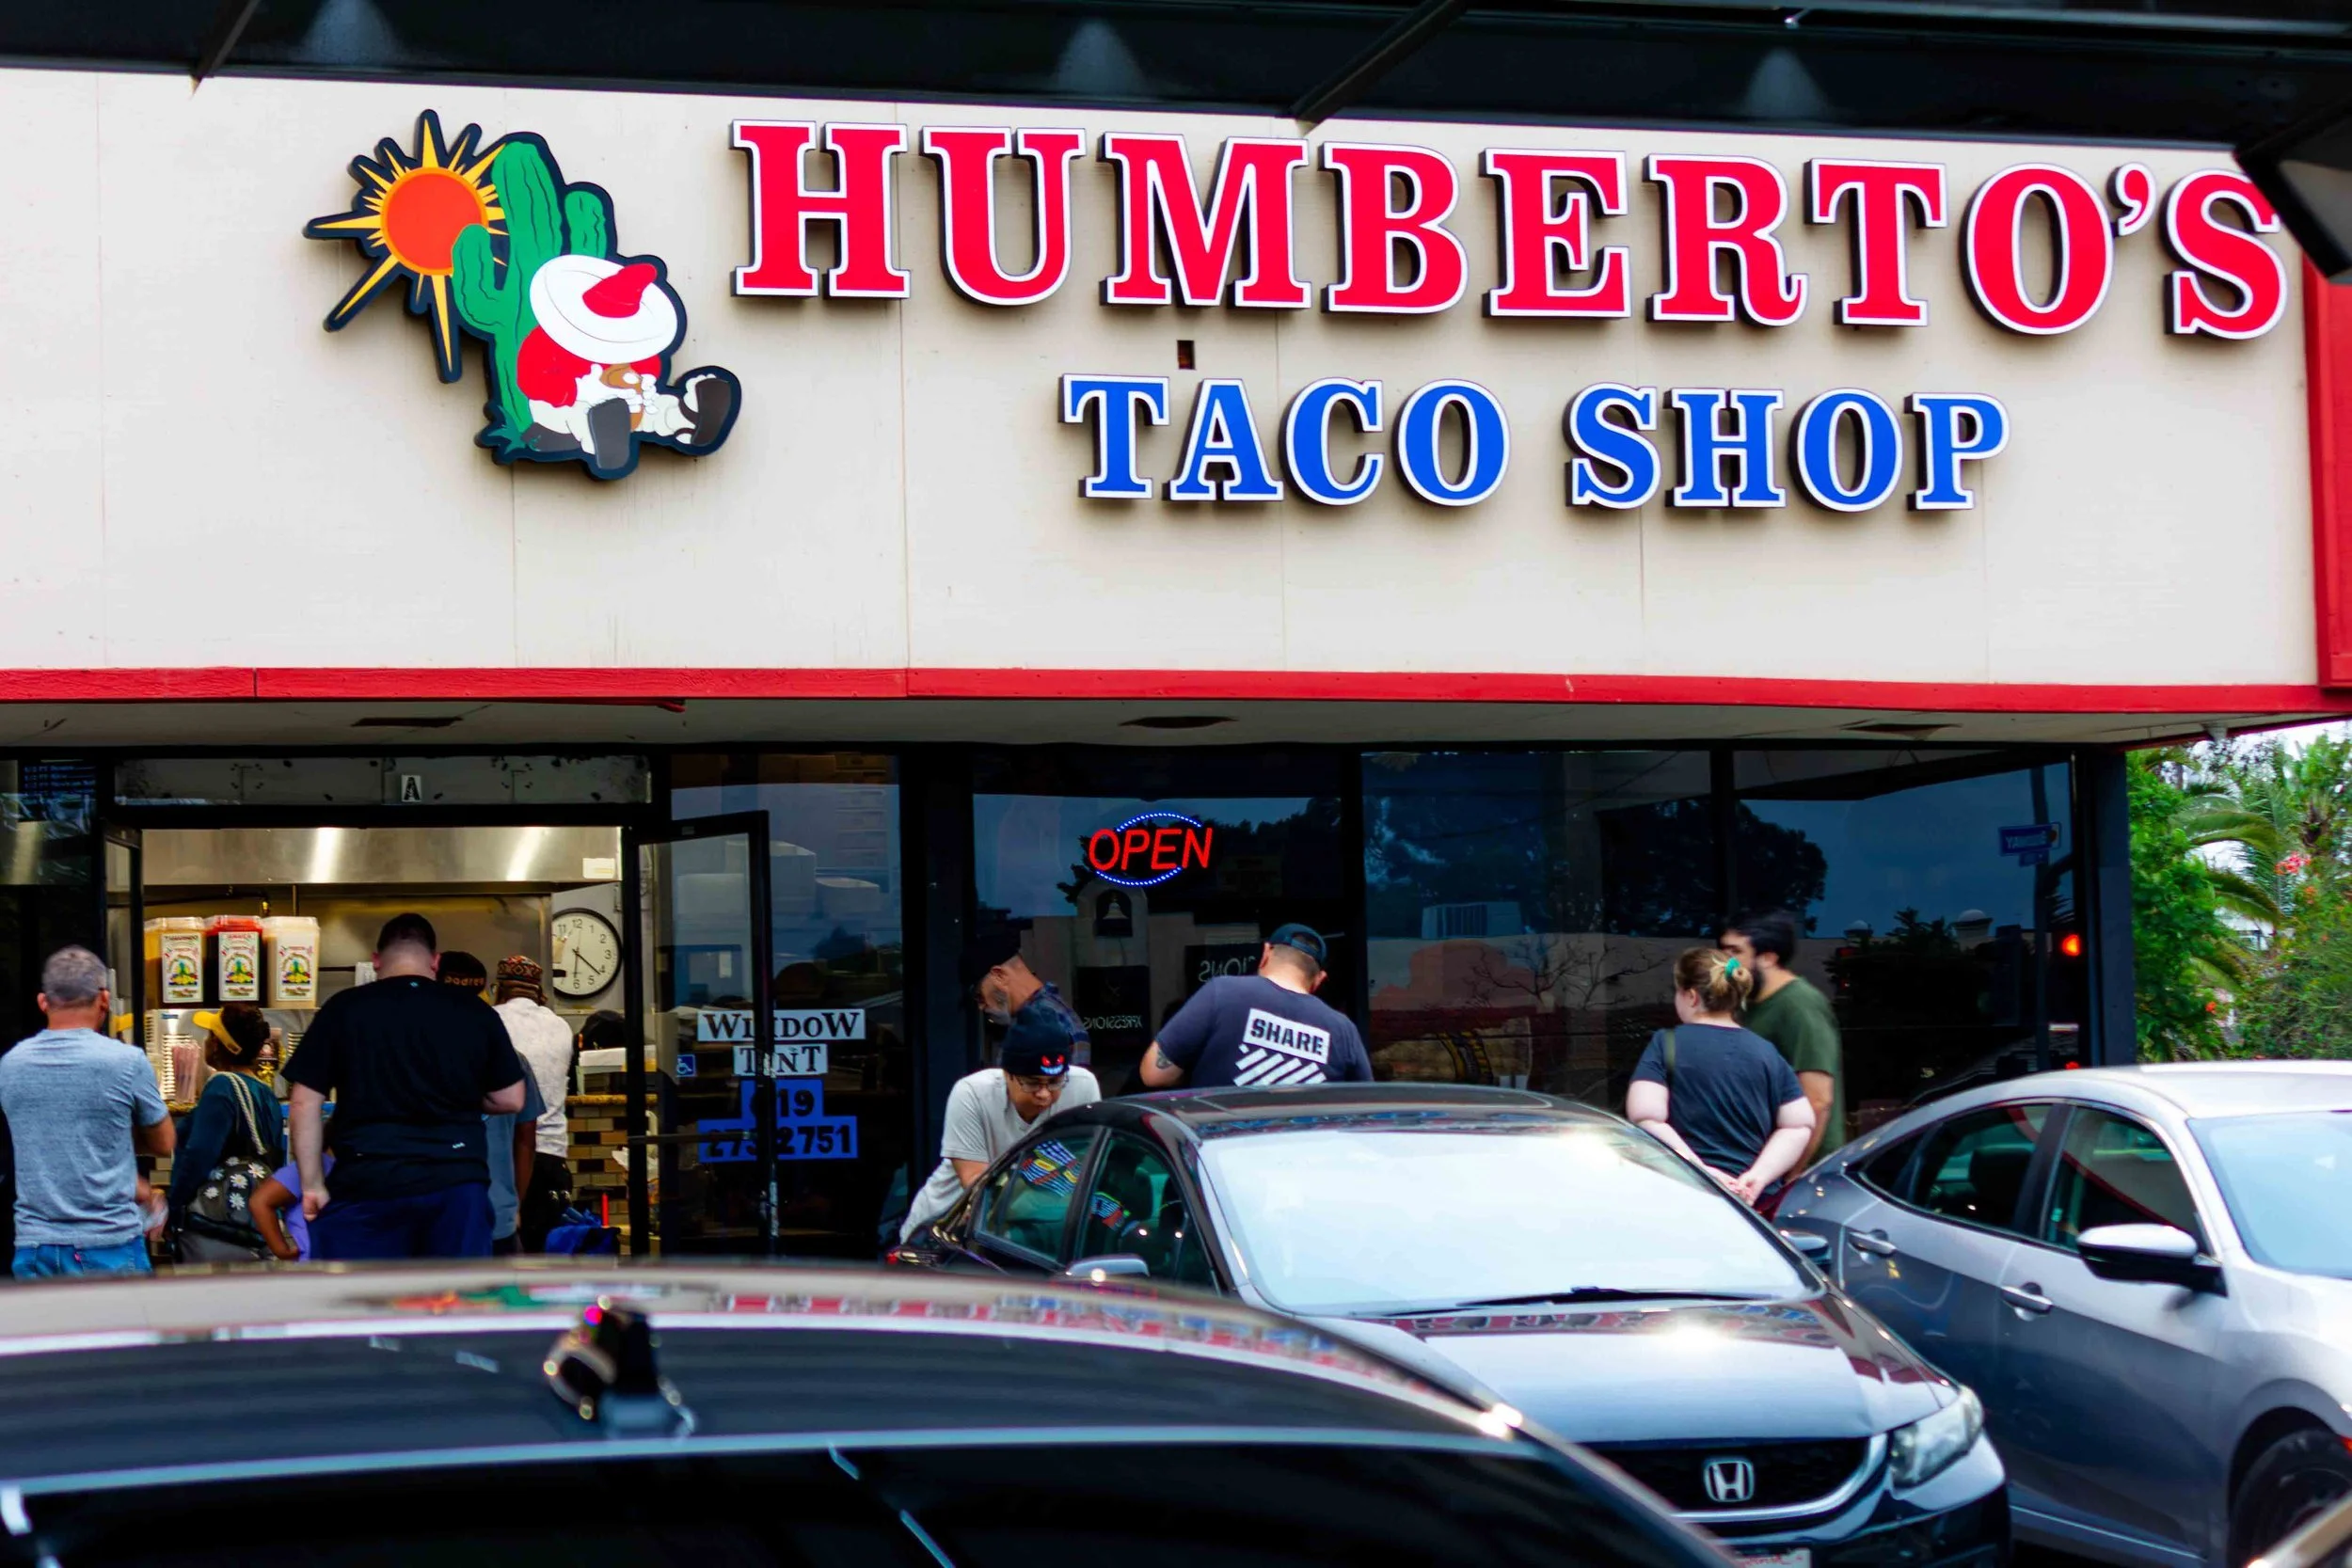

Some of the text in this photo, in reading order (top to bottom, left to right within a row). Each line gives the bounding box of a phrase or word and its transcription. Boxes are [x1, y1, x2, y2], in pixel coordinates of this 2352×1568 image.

[730, 119, 2288, 340] HUMBERTO'S
[1061, 373, 2010, 514] TACO SHOP
[403, 776, 421, 800] A
[1089, 828, 1214, 871] OPEN
[572, 918, 583, 929] 12
[599, 933, 607, 943] 2
[604, 949, 612, 959] 3
[573, 979, 580, 990] 6
[588, 974, 595, 985] 5
[704, 1012, 860, 1039] WIDOW
[1250, 1017, 1325, 1056] SHARE
[739, 1045, 821, 1074] TNT
[750, 1088, 815, 1117] 19
